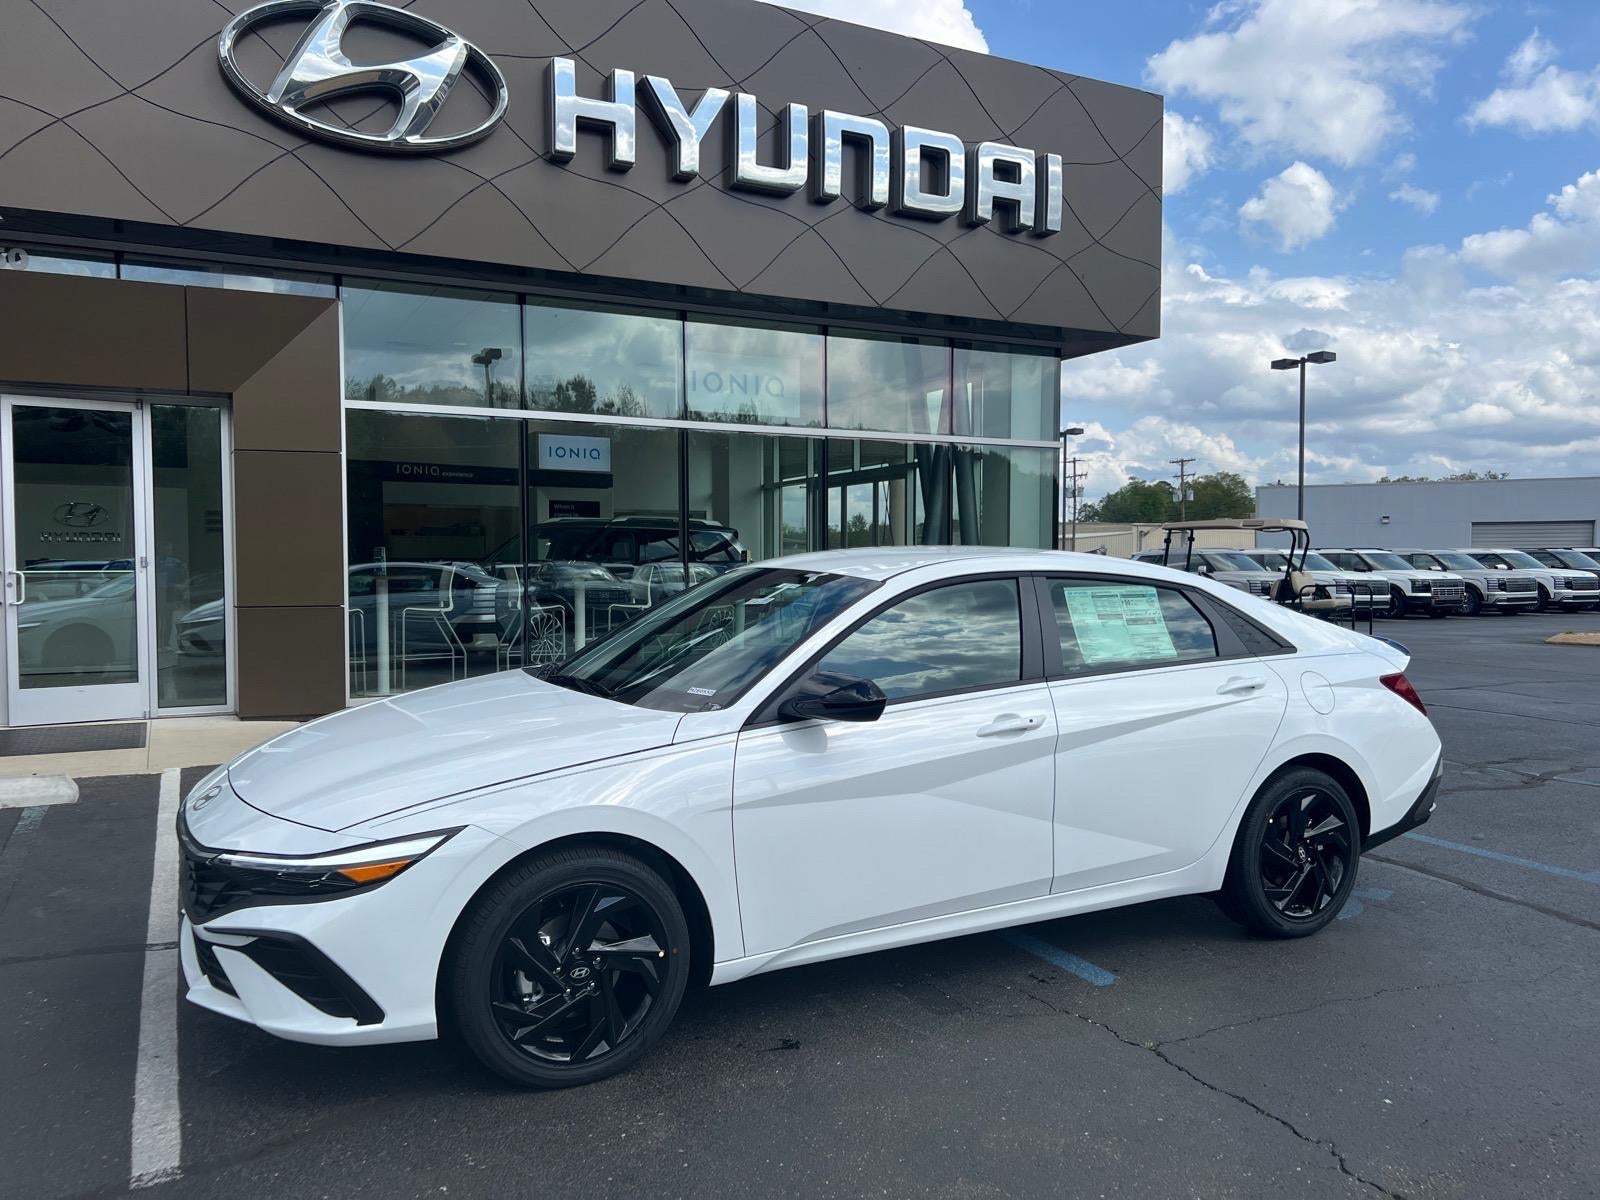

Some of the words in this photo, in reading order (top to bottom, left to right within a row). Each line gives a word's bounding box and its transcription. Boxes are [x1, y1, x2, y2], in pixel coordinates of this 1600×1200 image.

[548, 56, 1063, 237] HYUNDAI
[692, 370, 785, 397] IONIQ
[548, 446, 601, 460] IONIQ
[396, 463, 440, 476] IONIQ
